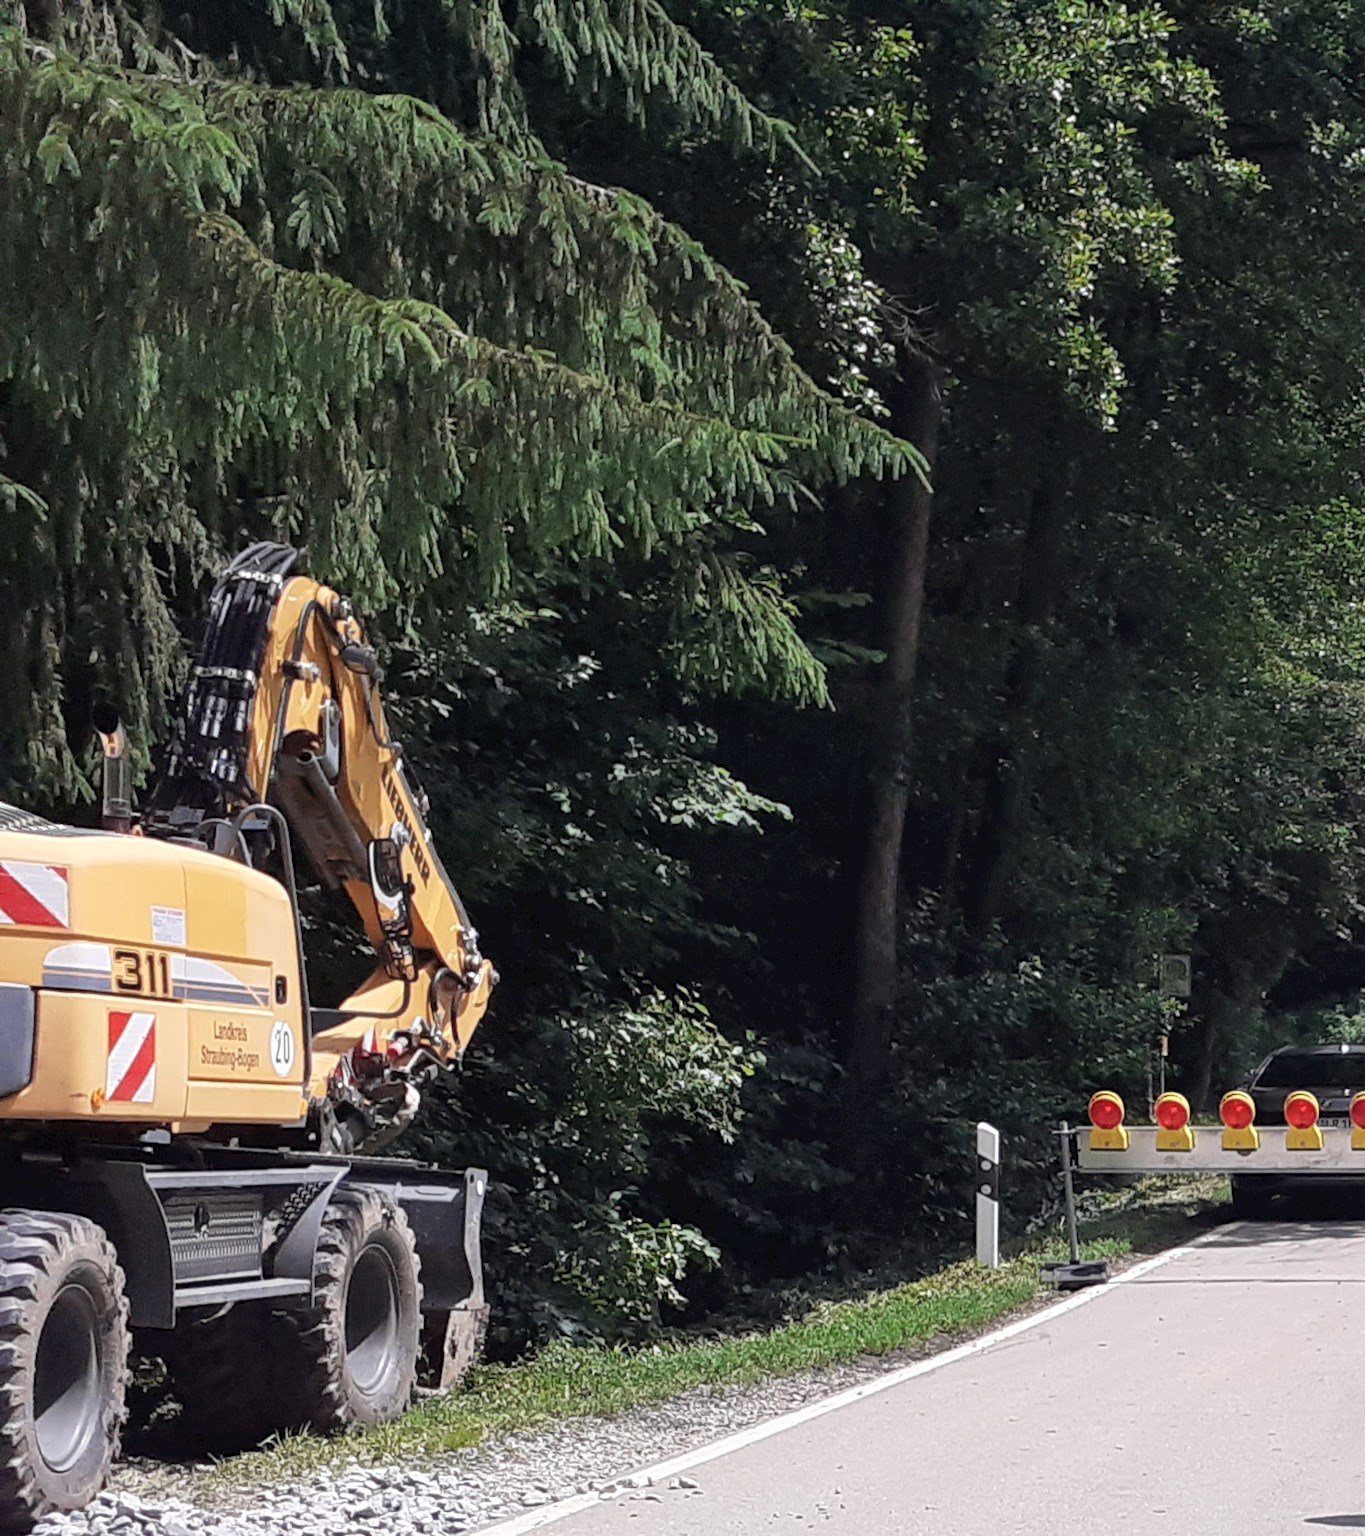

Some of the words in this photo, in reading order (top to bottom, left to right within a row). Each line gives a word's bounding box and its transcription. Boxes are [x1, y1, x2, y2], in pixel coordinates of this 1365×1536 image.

[381, 763, 430, 889] LIEBHERR
[113, 948, 169, 996] 311
[213, 1020, 248, 1042] Landkreis
[274, 1030, 290, 1064] 20
[200, 1045, 260, 1072] Straubing-Bogen
